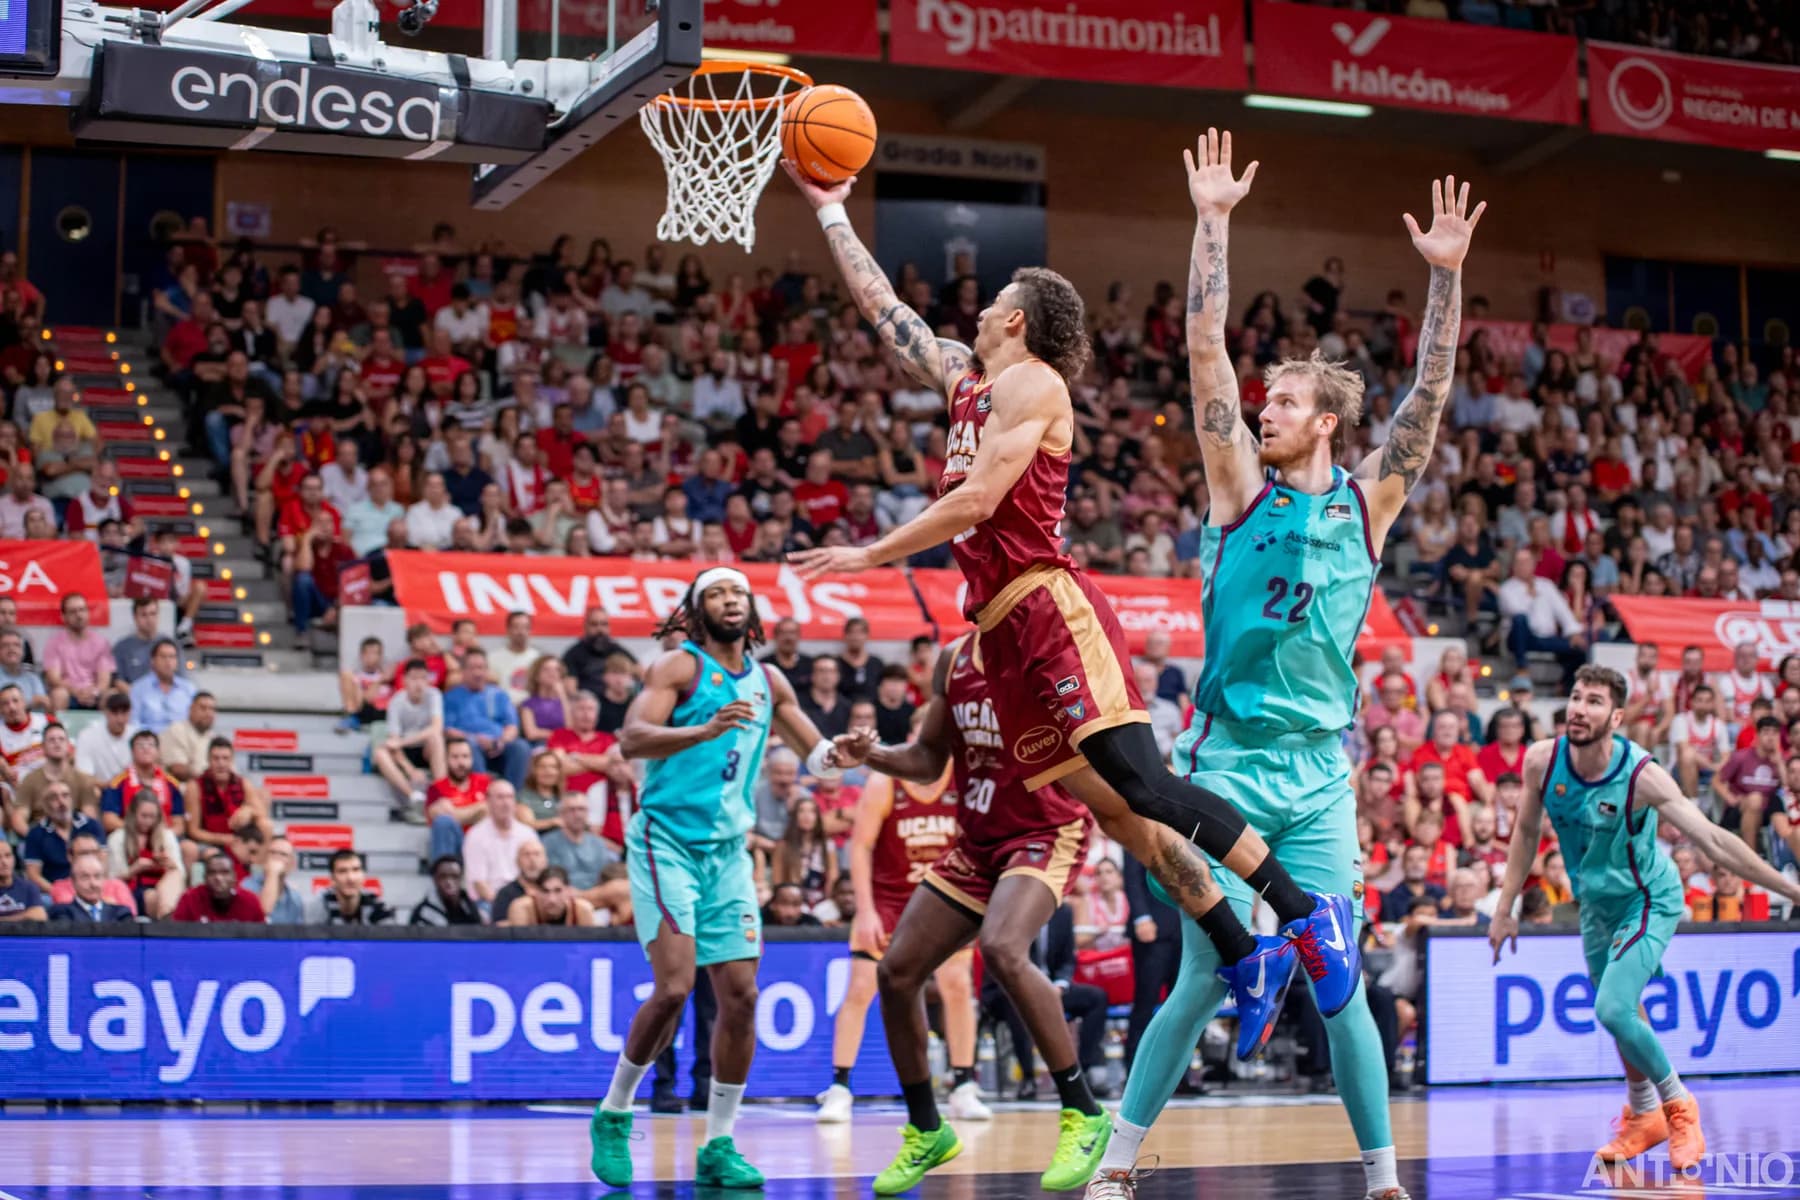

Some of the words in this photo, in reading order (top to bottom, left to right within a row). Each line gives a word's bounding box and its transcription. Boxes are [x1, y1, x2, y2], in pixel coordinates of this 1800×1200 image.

[977, 3, 1221, 57] patrimonial
[171, 66, 441, 142] endesa
[1332, 59, 1453, 104] Halcón
[1261, 576, 1314, 624] 22
[721, 749, 741, 782] 3
[1021, 733, 1057, 758] Juver
[964, 777, 996, 814] 20
[897, 815, 957, 838] UCAM
[1494, 968, 1782, 1066] peayo
